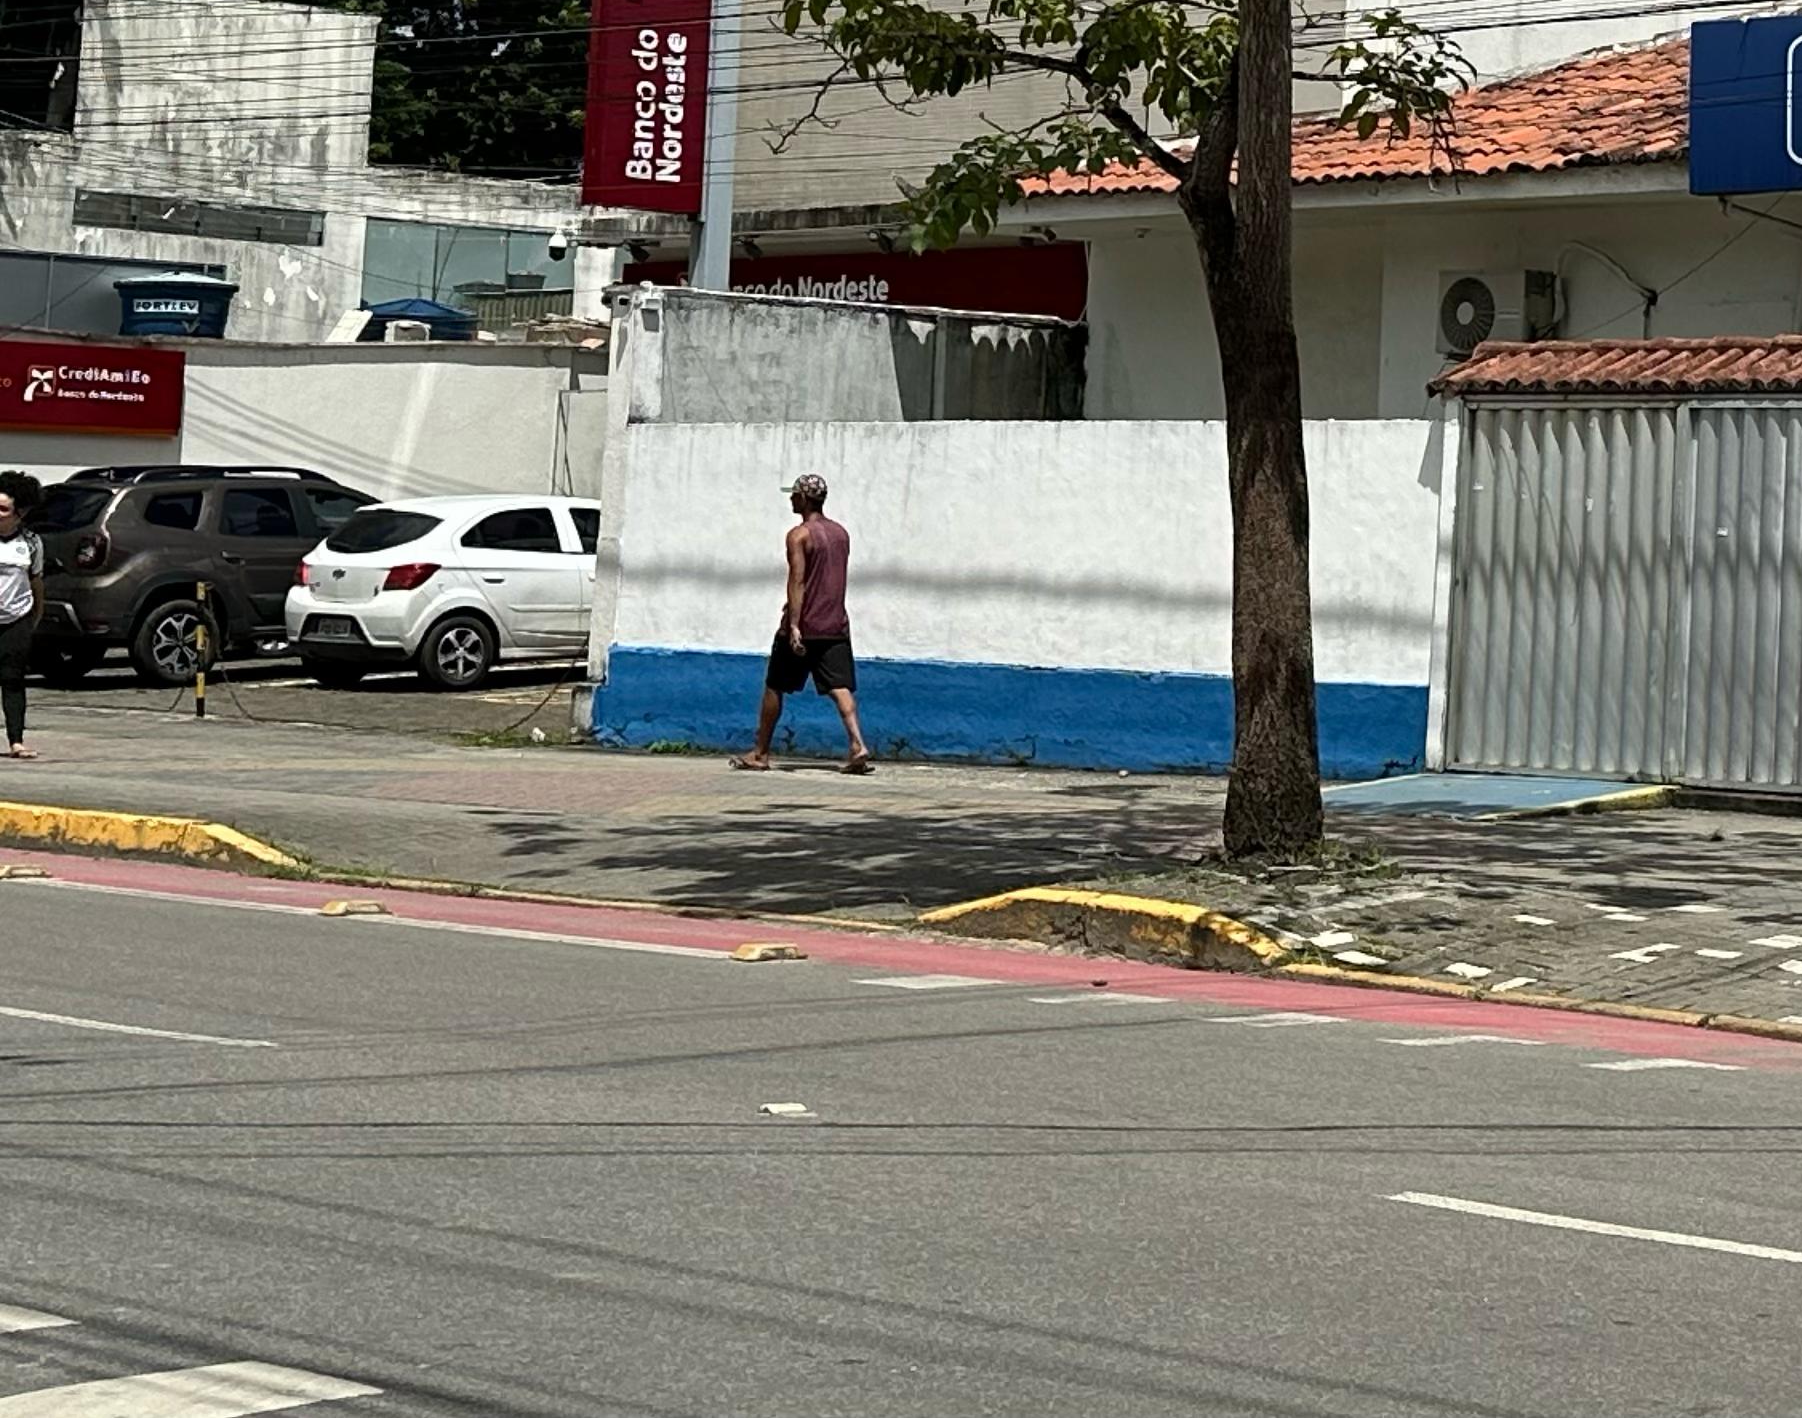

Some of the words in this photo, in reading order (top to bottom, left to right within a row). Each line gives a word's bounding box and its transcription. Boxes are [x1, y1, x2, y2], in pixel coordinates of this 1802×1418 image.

[631, 29, 660, 71] do
[625, 80, 657, 181] Banco
[655, 32, 688, 183] Nordeste
